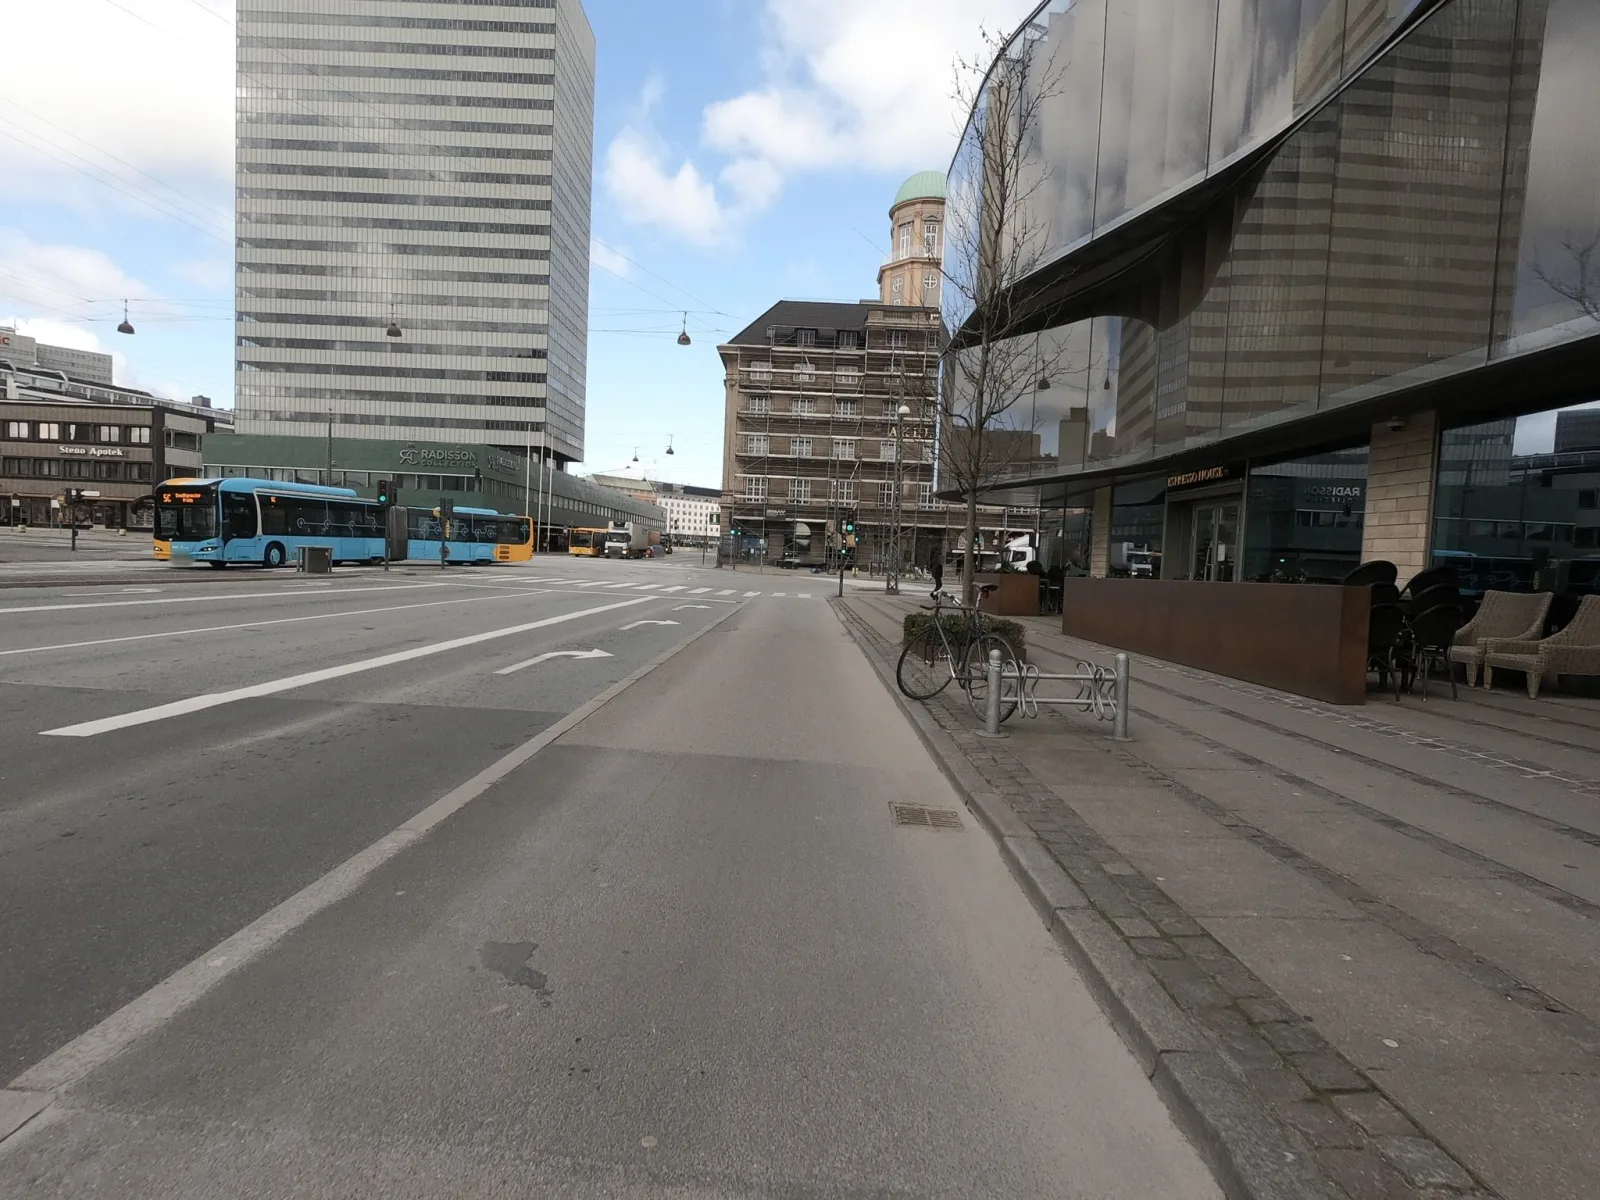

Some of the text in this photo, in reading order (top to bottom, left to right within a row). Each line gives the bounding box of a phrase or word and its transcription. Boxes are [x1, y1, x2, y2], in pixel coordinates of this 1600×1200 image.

[59, 446, 123, 457] Steno Apotek
[421, 449, 477, 461] RADISSON
[421, 460, 479, 468] COLLECTION
[1167, 466, 1224, 487] ESPRESSO HOUSE
[163, 493, 172, 502] 5C
